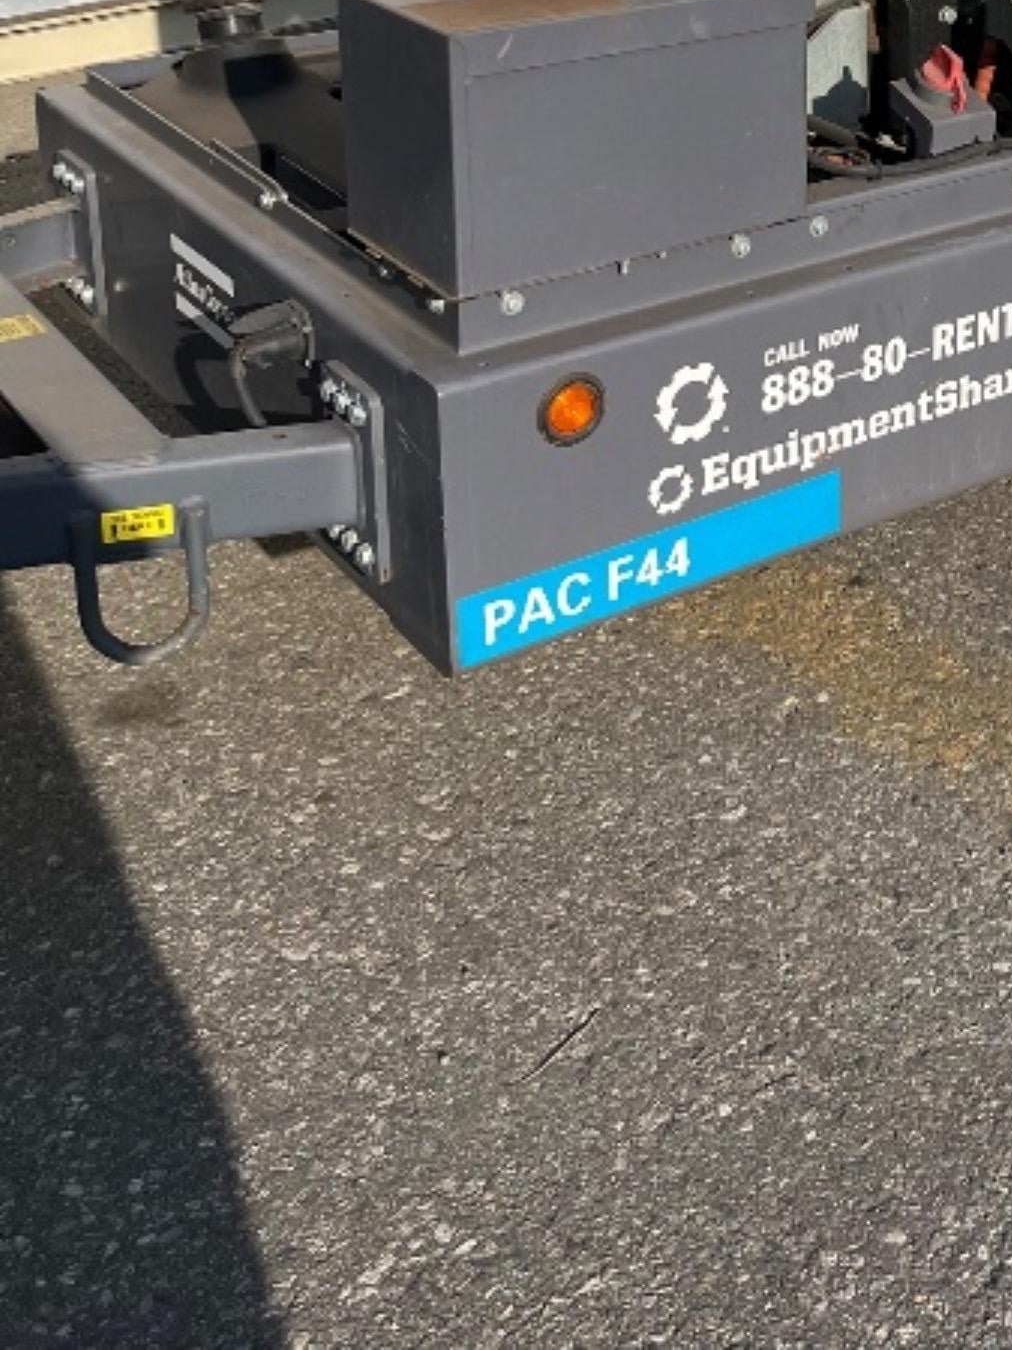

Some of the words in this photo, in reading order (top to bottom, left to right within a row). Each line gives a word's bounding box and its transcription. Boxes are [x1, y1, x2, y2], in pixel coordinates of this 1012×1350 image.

[763, 338, 811, 368] CALL
[818, 323, 860, 352] NOW
[482, 571, 592, 647] PAC
[607, 536, 691, 602] F44
